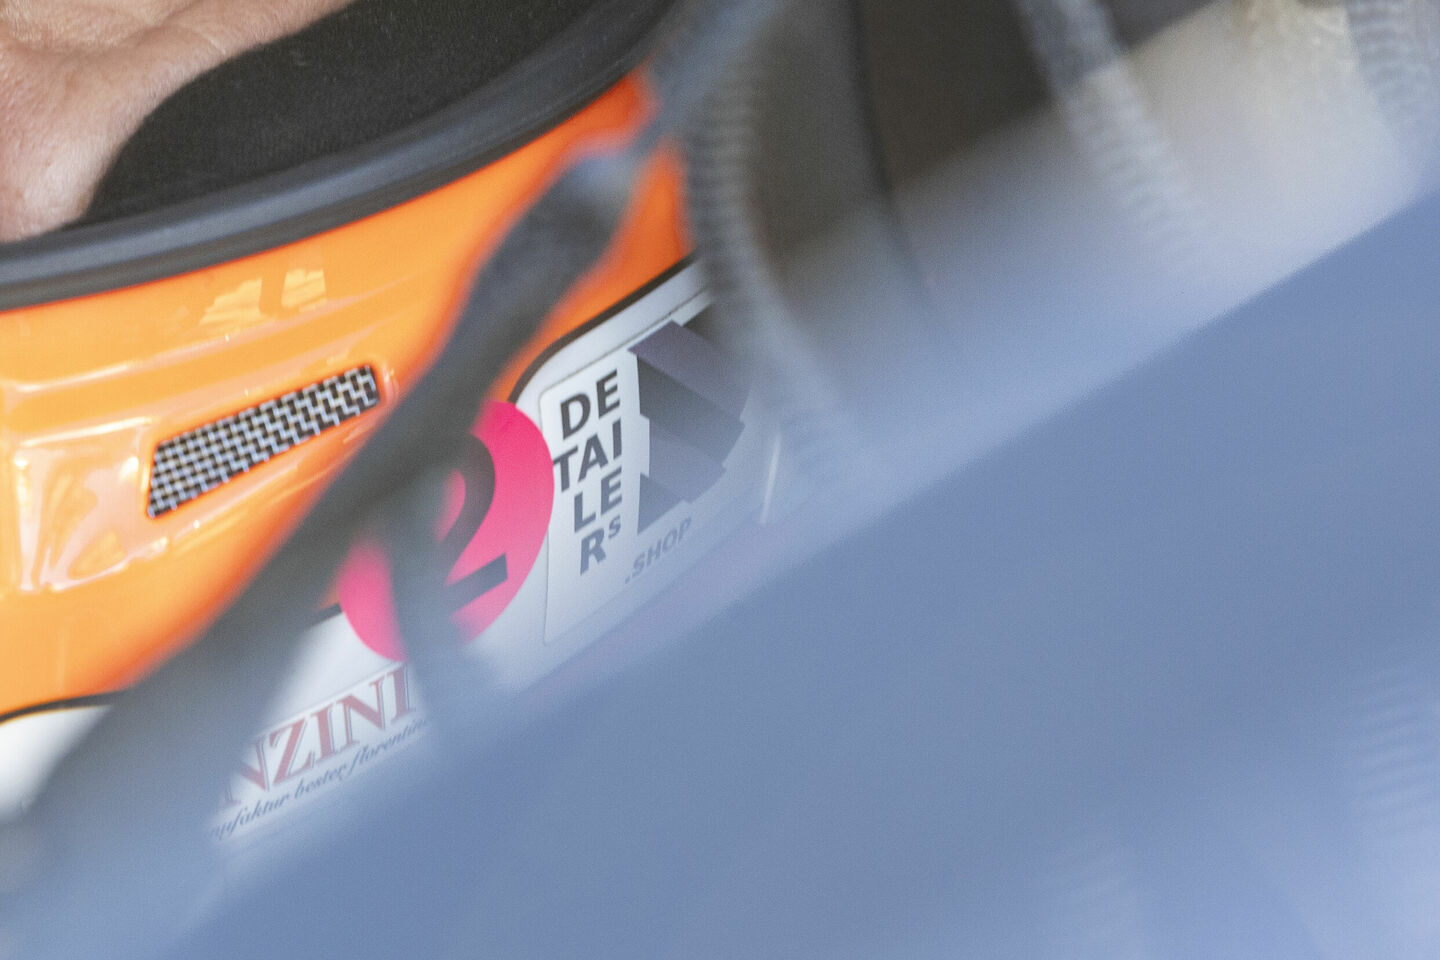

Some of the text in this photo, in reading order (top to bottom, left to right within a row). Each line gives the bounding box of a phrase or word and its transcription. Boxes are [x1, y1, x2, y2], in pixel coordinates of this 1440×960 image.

[559, 368, 622, 441] DE
[553, 417, 623, 493] TAI
[573, 466, 623, 533] LE
